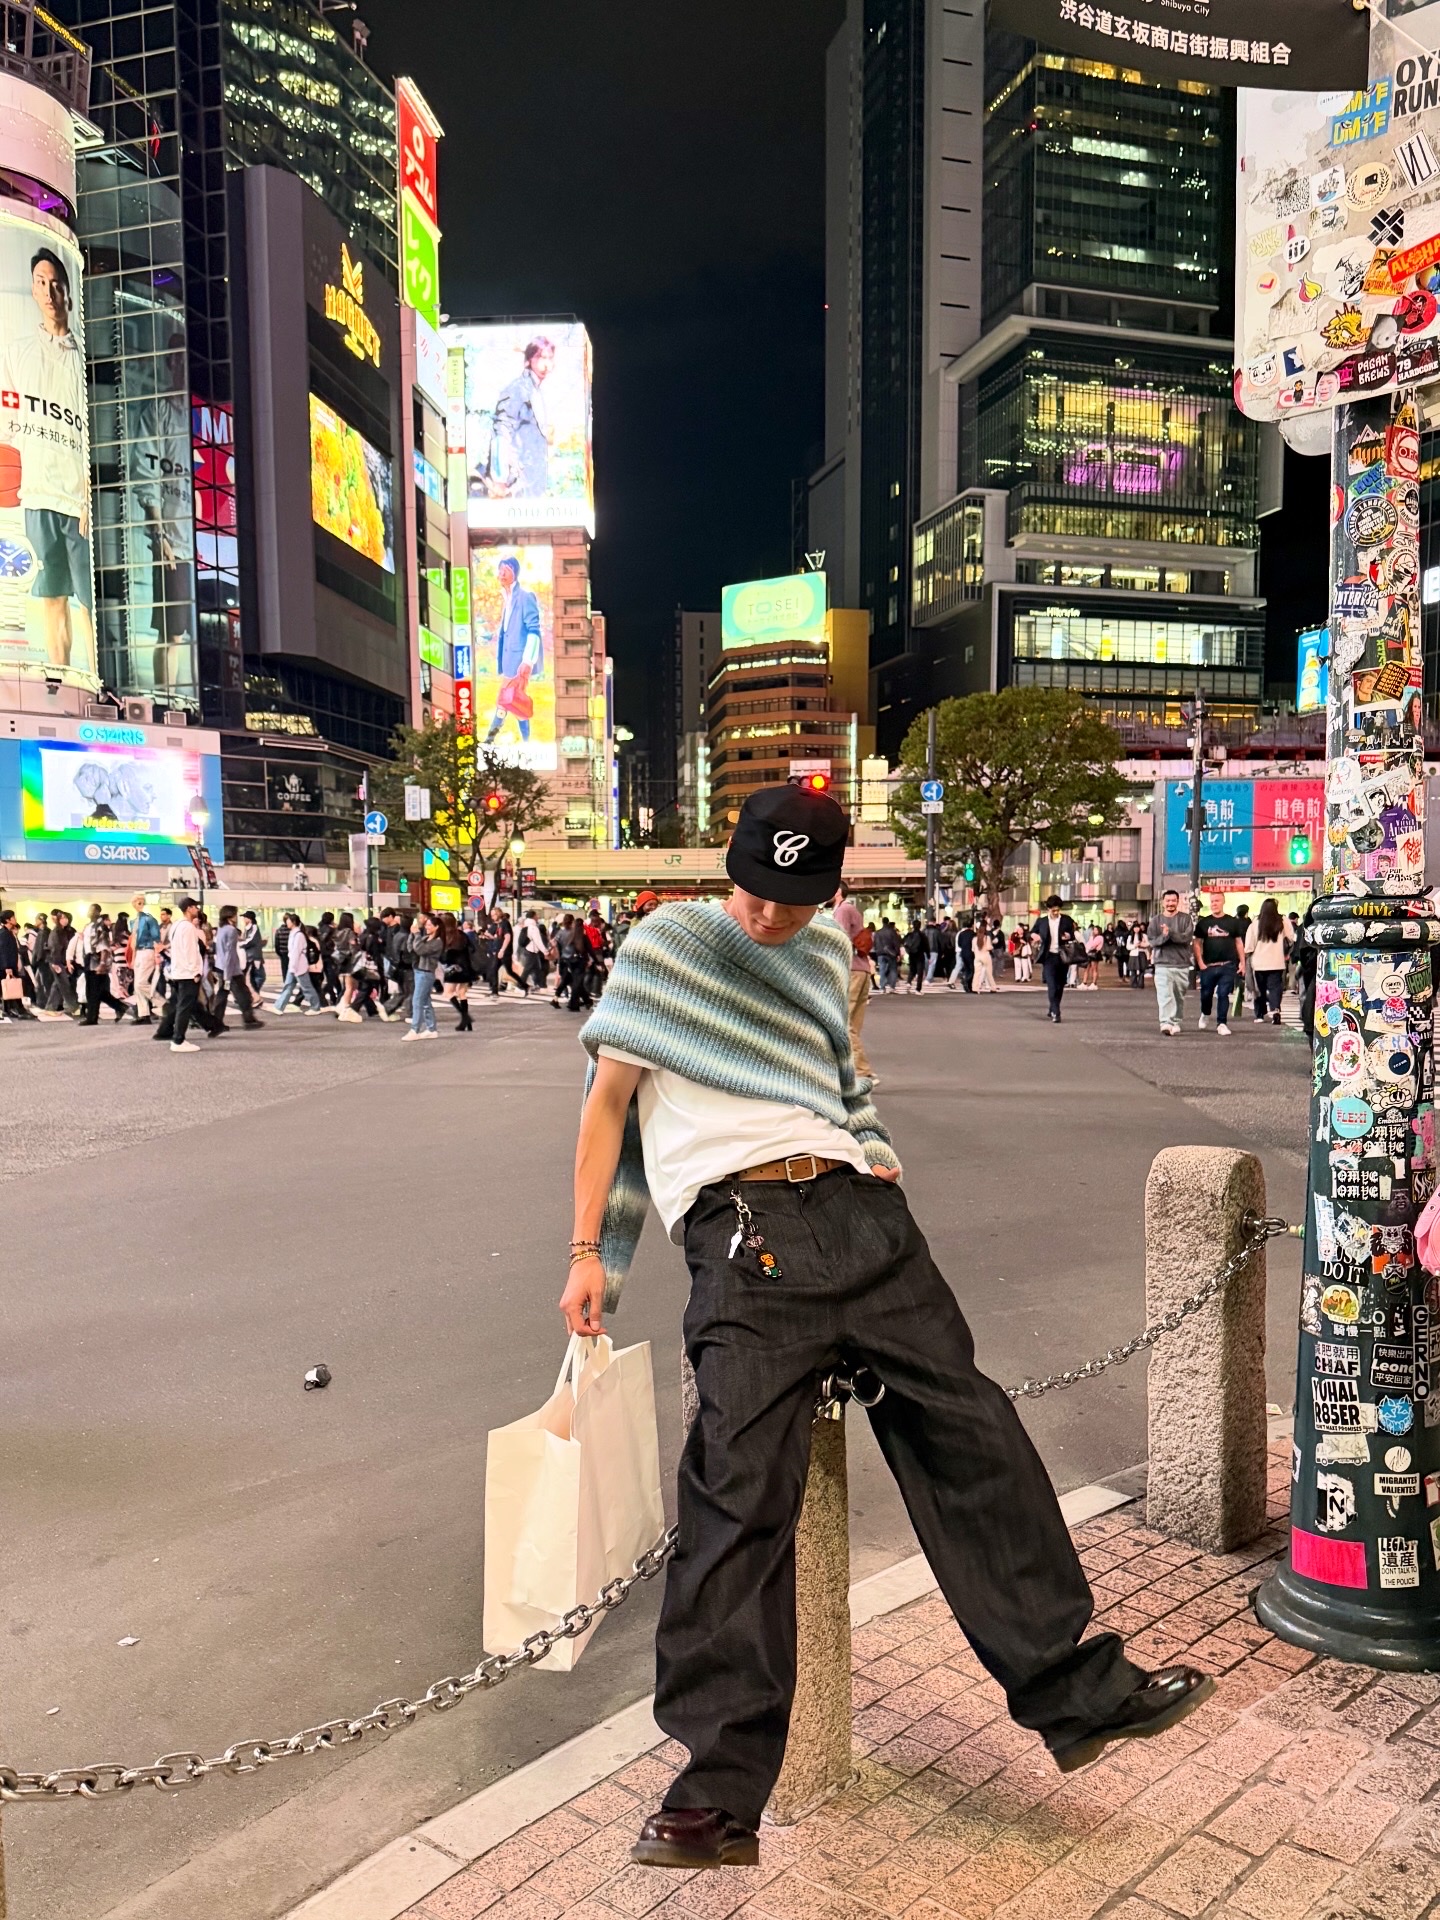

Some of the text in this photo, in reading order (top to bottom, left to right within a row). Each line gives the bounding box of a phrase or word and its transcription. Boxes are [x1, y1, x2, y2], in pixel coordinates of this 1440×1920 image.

[1160, 0, 1210, 17] Shibuya City
[1060, 0, 1292, 65] 渋谷道玄坂商店街振興組合
[325, 283, 380, 368] MAGNET
[1358, 353, 1388, 373] PAGAN
[1397, 359, 1412, 373] 79
[1398, 361, 1438, 382] HARDCORE
[1358, 365, 1390, 385] BREWS
[24, 394, 86, 432] TISSO
[747, 597, 799, 616] TOSEI
[277, 792, 311, 802] COFFEE
[1188, 799, 1235, 822] 角散
[1274, 798, 1321, 820] 龍角散
[102, 846, 150, 861] STARTS
[664, 854, 682, 865] JR
[1378, 1116, 1409, 1125] Embedded
[1323, 1261, 1365, 1284] DO IT
[1315, 1356, 1359, 1376] CHAF
[1375, 1373, 1411, 1384] 平安回家
[1379, 1476, 1417, 1484] MIGRANTES
[1382, 1486, 1416, 1494] VALIENTES
[1397, 1577, 1415, 1586] POLICE
